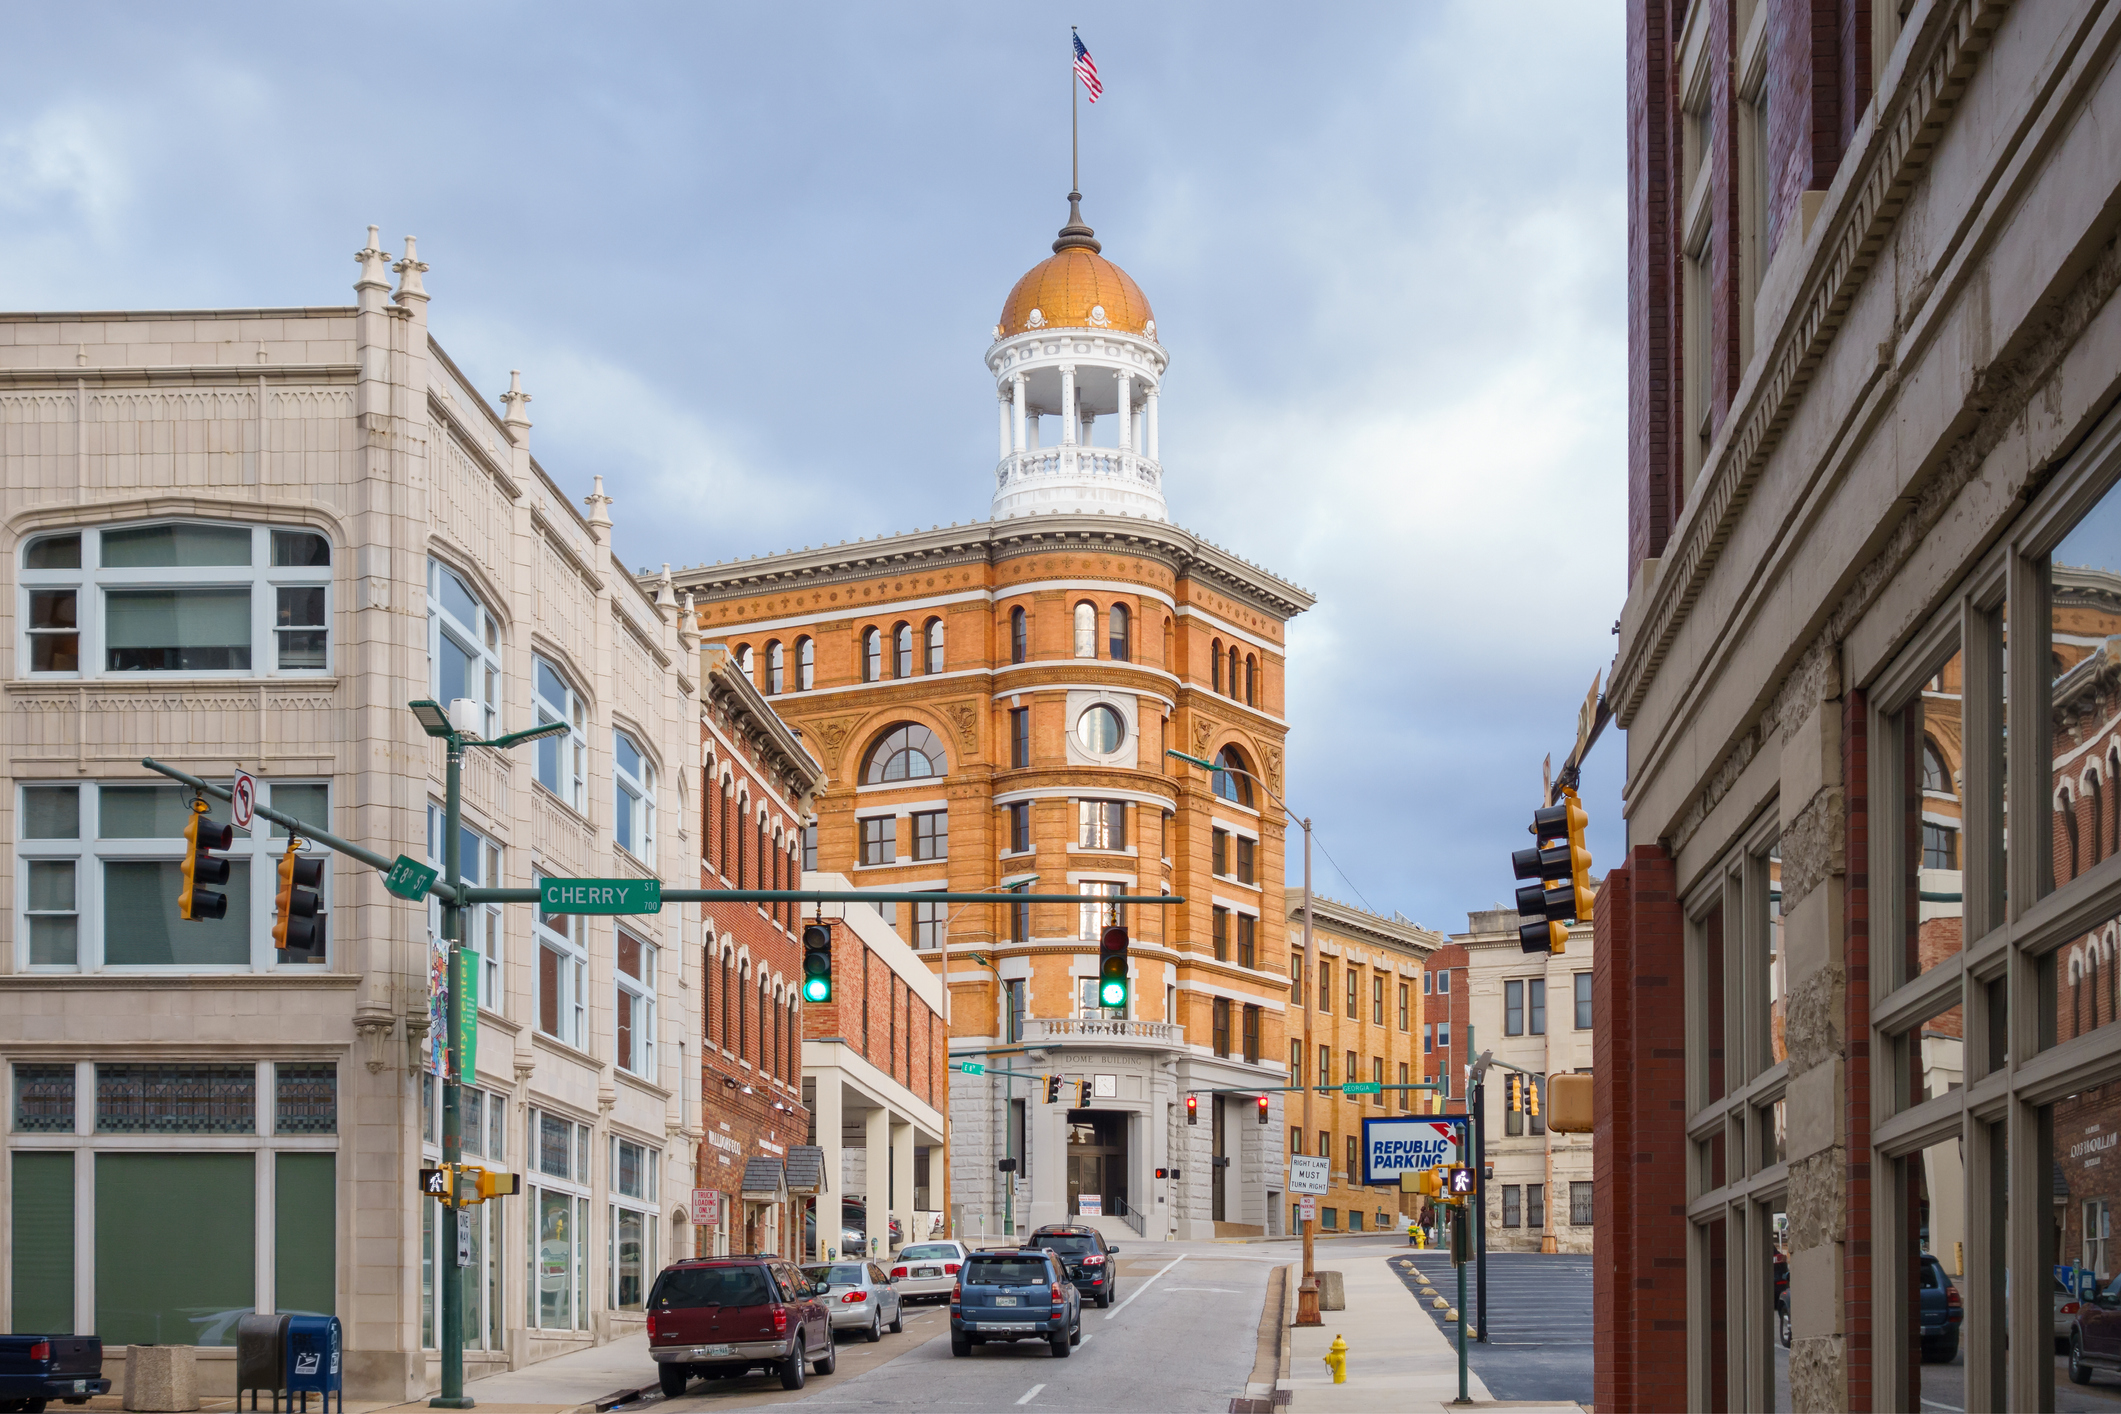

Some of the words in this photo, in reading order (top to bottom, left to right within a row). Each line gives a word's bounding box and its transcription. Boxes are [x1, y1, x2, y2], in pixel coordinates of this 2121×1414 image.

[391, 863, 402, 880] E
[413, 874, 427, 891] ST
[644, 882, 654, 892] ST
[547, 886, 630, 905] CHERRY
[644, 901, 658, 911] 700
[1065, 1055, 1094, 1063] DOME
[1101, 1056, 1142, 1065] BUILDING
[1373, 1139, 1448, 1154] REPUBLIC
[1373, 1154, 1443, 1169] PARKING
[1299, 1171, 1320, 1179] MUST
[1309, 1182, 1326, 1190] RIGHT
[459, 1214, 469, 1228] ONE
[459, 1230, 469, 1244] WAY
